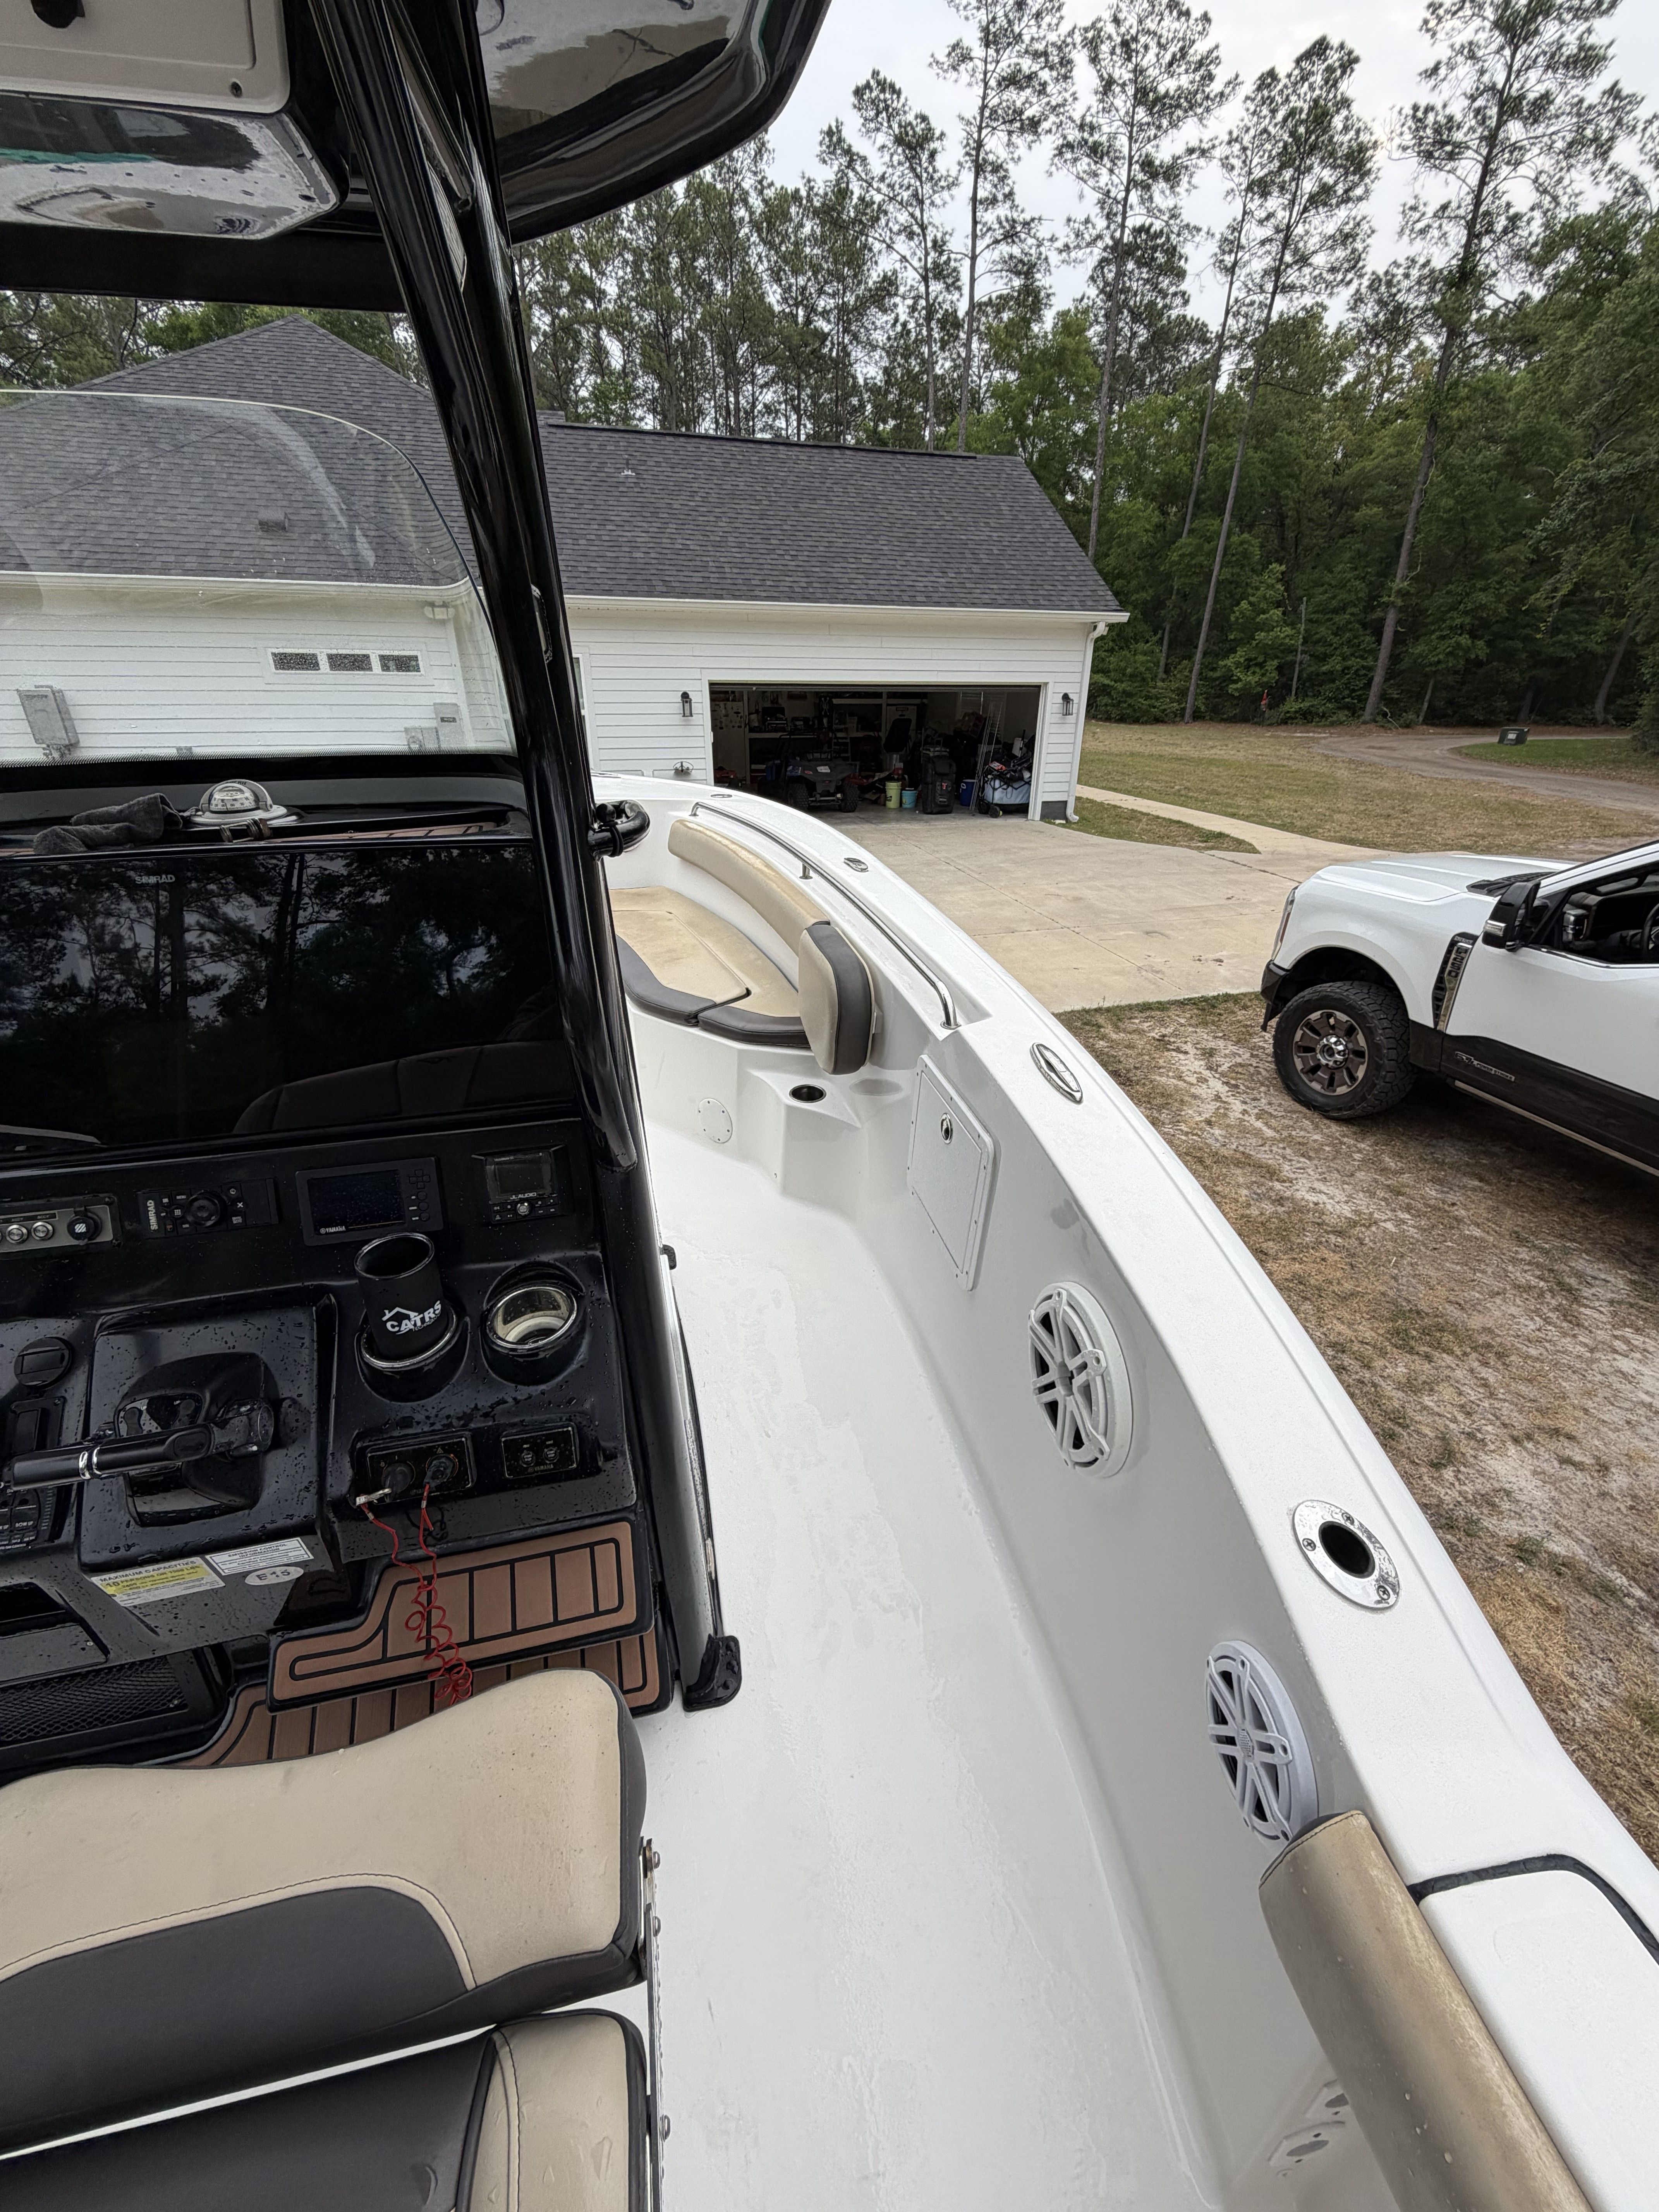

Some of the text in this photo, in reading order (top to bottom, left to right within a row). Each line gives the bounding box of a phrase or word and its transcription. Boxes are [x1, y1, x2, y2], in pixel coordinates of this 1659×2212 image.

[135, 874, 175, 884] SIMRAD
[147, 1200, 158, 1230] SIMRAD
[100, 1570, 143, 1582] MAXIMUM
[145, 1560, 196, 1573] CAPACITIES
[120, 1574, 155, 1584] PERSONS
